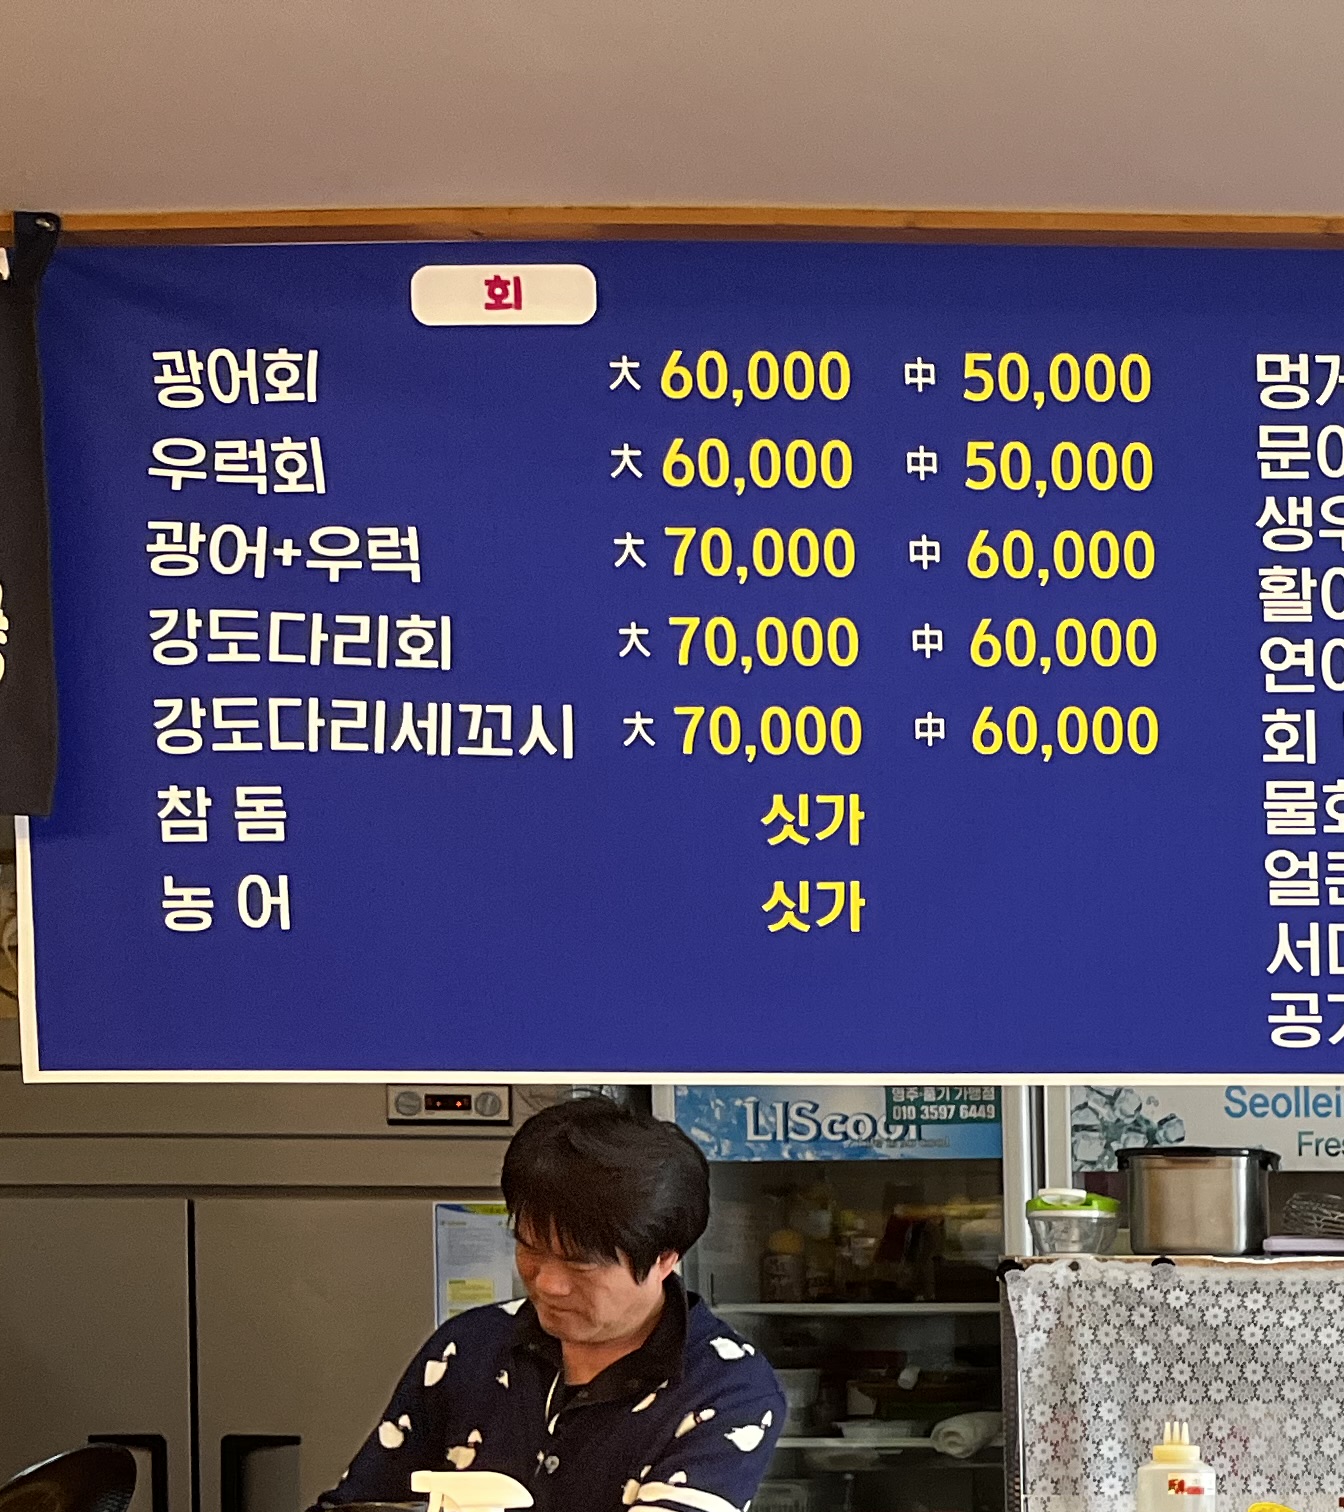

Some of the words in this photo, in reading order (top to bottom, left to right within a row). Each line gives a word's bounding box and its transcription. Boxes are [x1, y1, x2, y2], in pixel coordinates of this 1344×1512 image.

[484, 275, 523, 312] 회
[153, 348, 318, 408] 광어회
[610, 355, 641, 390] 大
[661, 350, 850, 406] 60,000
[905, 357, 935, 392] 中
[964, 353, 1150, 410] 50,000
[148, 437, 325, 494] 우럭회
[611, 443, 642, 478] 大
[663, 438, 852, 496] 60,000
[907, 446, 937, 480] 中
[965, 441, 1152, 498] 50,000
[147, 521, 420, 582] 광어+우럭
[614, 532, 646, 567] 大
[665, 527, 855, 584] 70,000
[909, 534, 940, 570] 中
[968, 530, 1154, 586] 60,000
[150, 609, 450, 670] 강도다리회
[619, 622, 650, 657] 大
[669, 617, 858, 674] 70,000
[912, 623, 942, 658] 中
[971, 618, 1156, 674] 60,000
[153, 697, 573, 759] 강도다리세꼬시
[623, 711, 655, 746] 大
[674, 706, 861, 762] 70,000
[915, 712, 945, 746] 中
[972, 706, 1158, 762] 60,000
[1262, 709, 1316, 764] 회
[761, 794, 865, 845] 싯가
[762, 881, 865, 932] 싯가
[892, 1104, 917, 1121] 010
[920, 1104, 956, 1121] 3597
[959, 1104, 996, 1120] 6449
